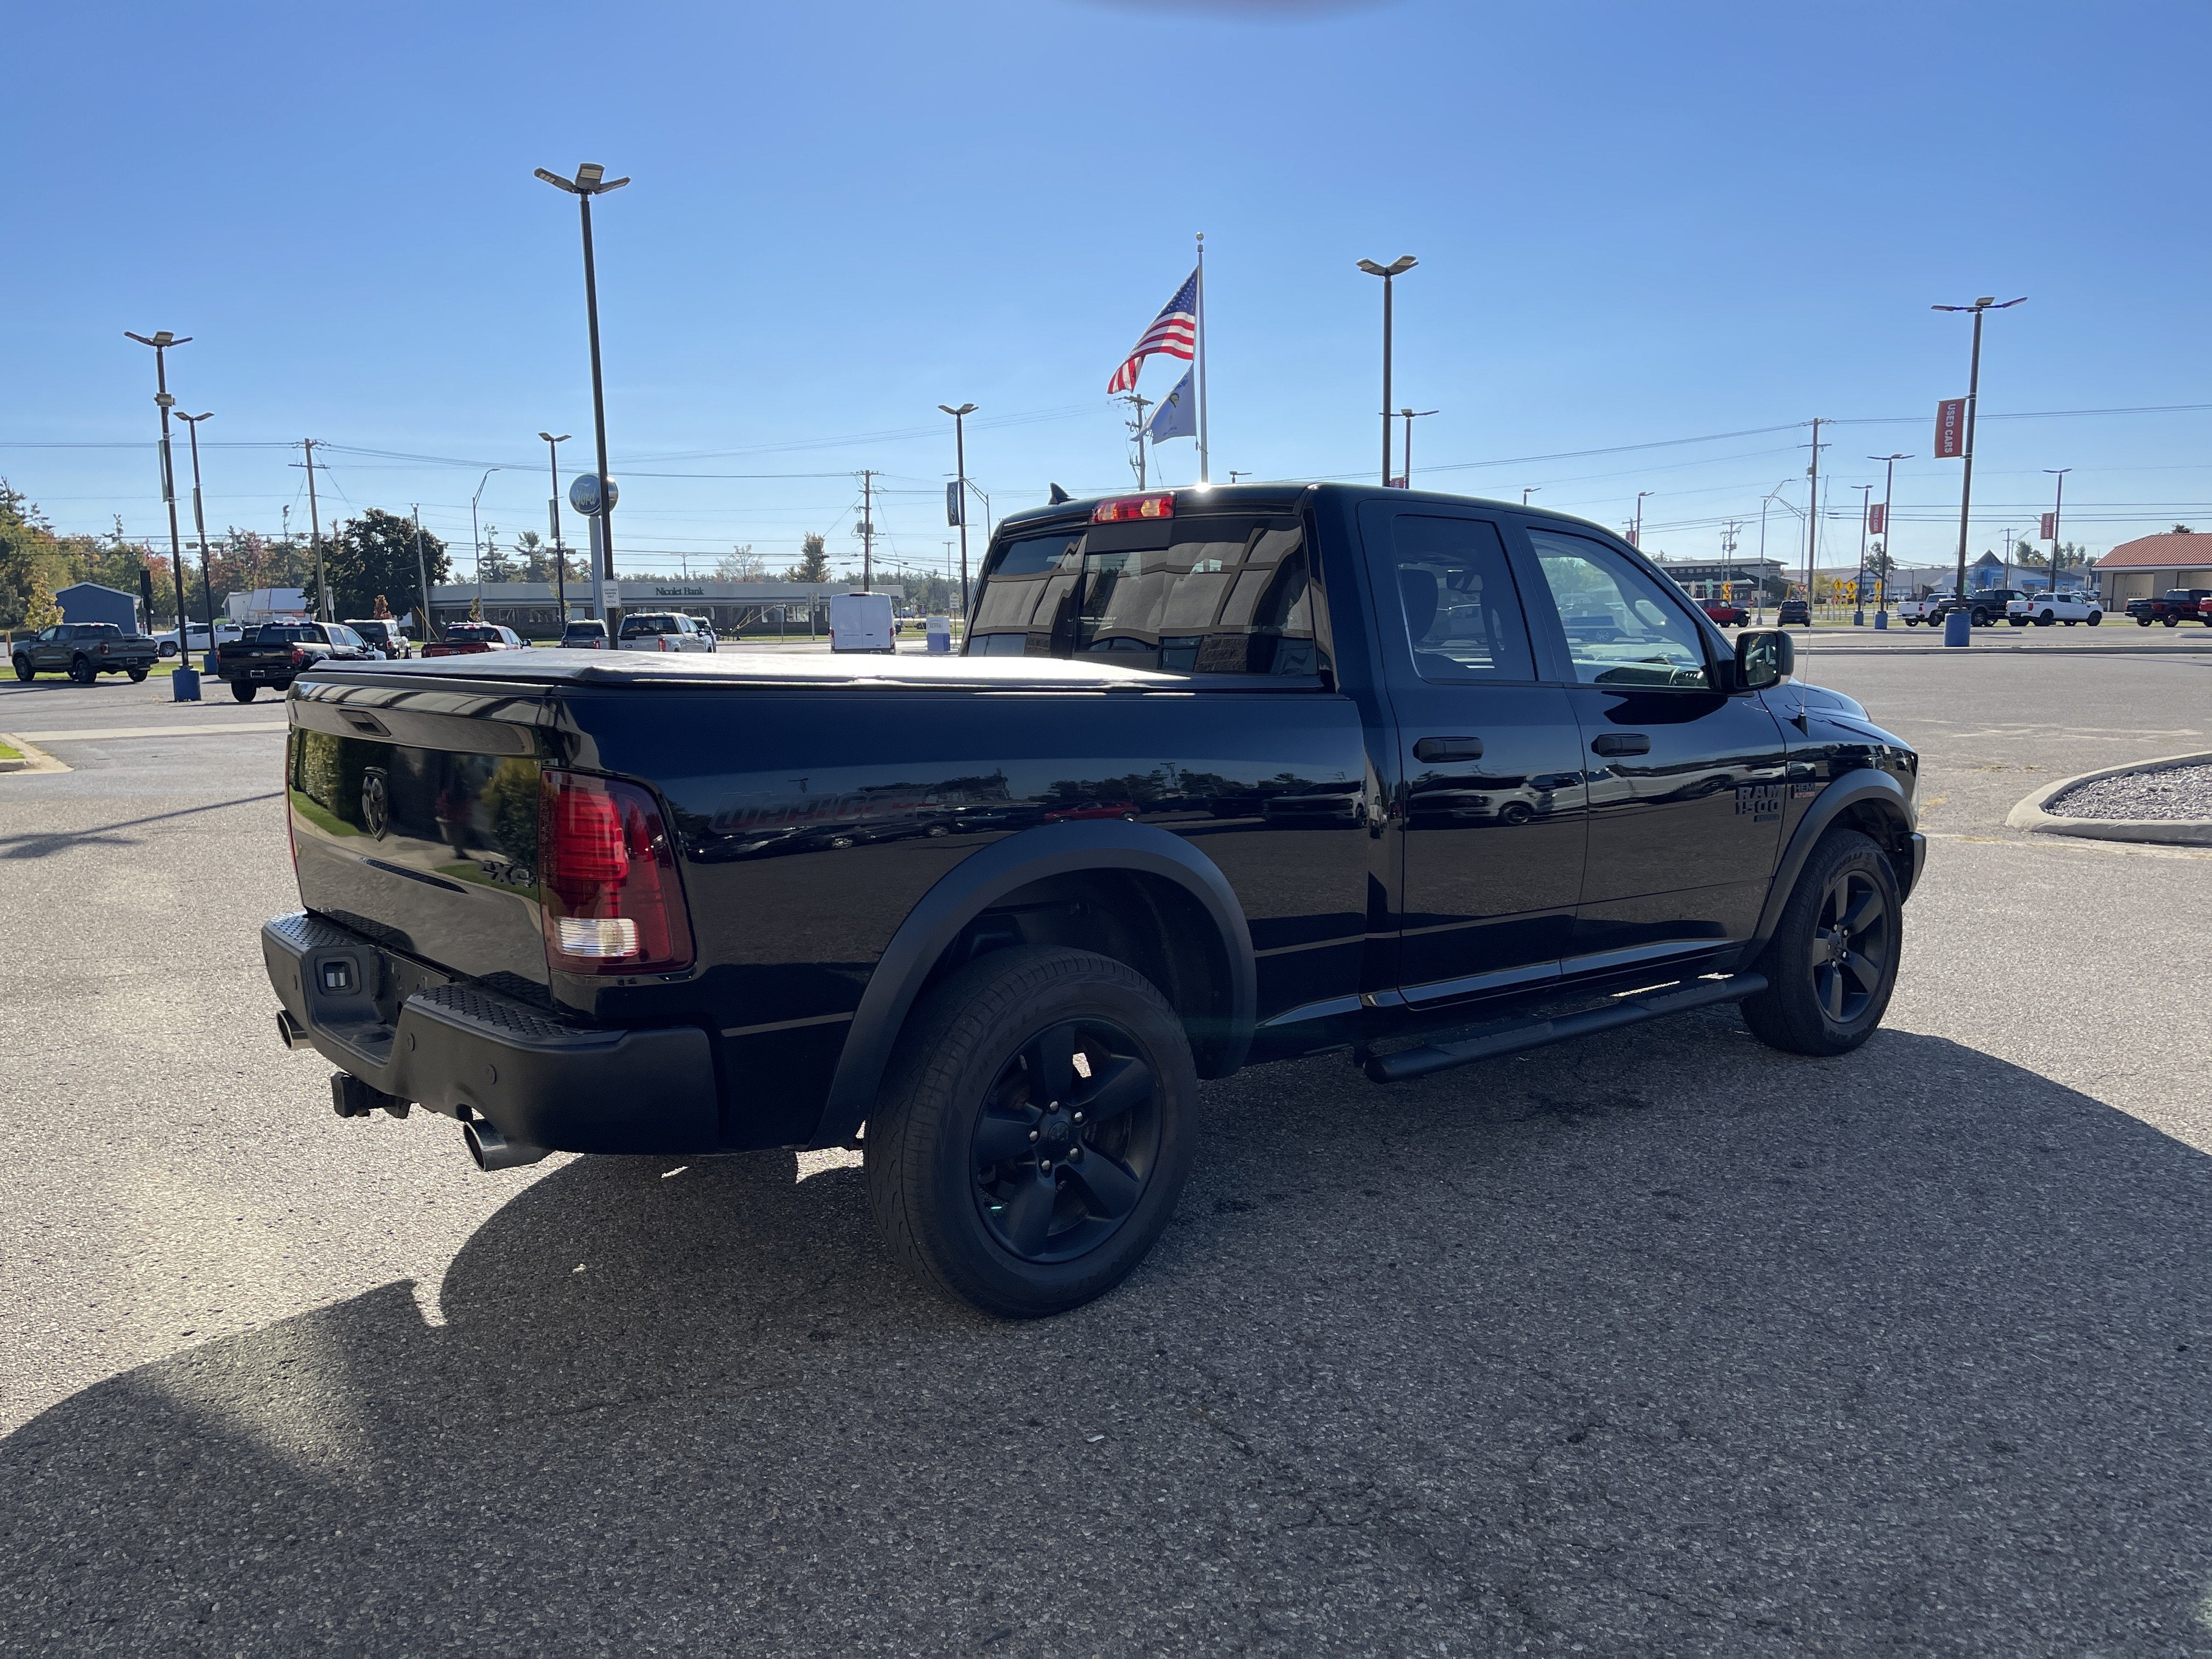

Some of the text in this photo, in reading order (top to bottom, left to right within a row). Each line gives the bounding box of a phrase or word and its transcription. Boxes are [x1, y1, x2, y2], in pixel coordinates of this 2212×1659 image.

[1944, 403, 1956, 454] USED CARS
[575, 483, 597, 506] Ford
[656, 586, 704, 595] Nicolet Bank
[1736, 785, 1782, 800] RAM
[1736, 799, 1780, 815] 1500
